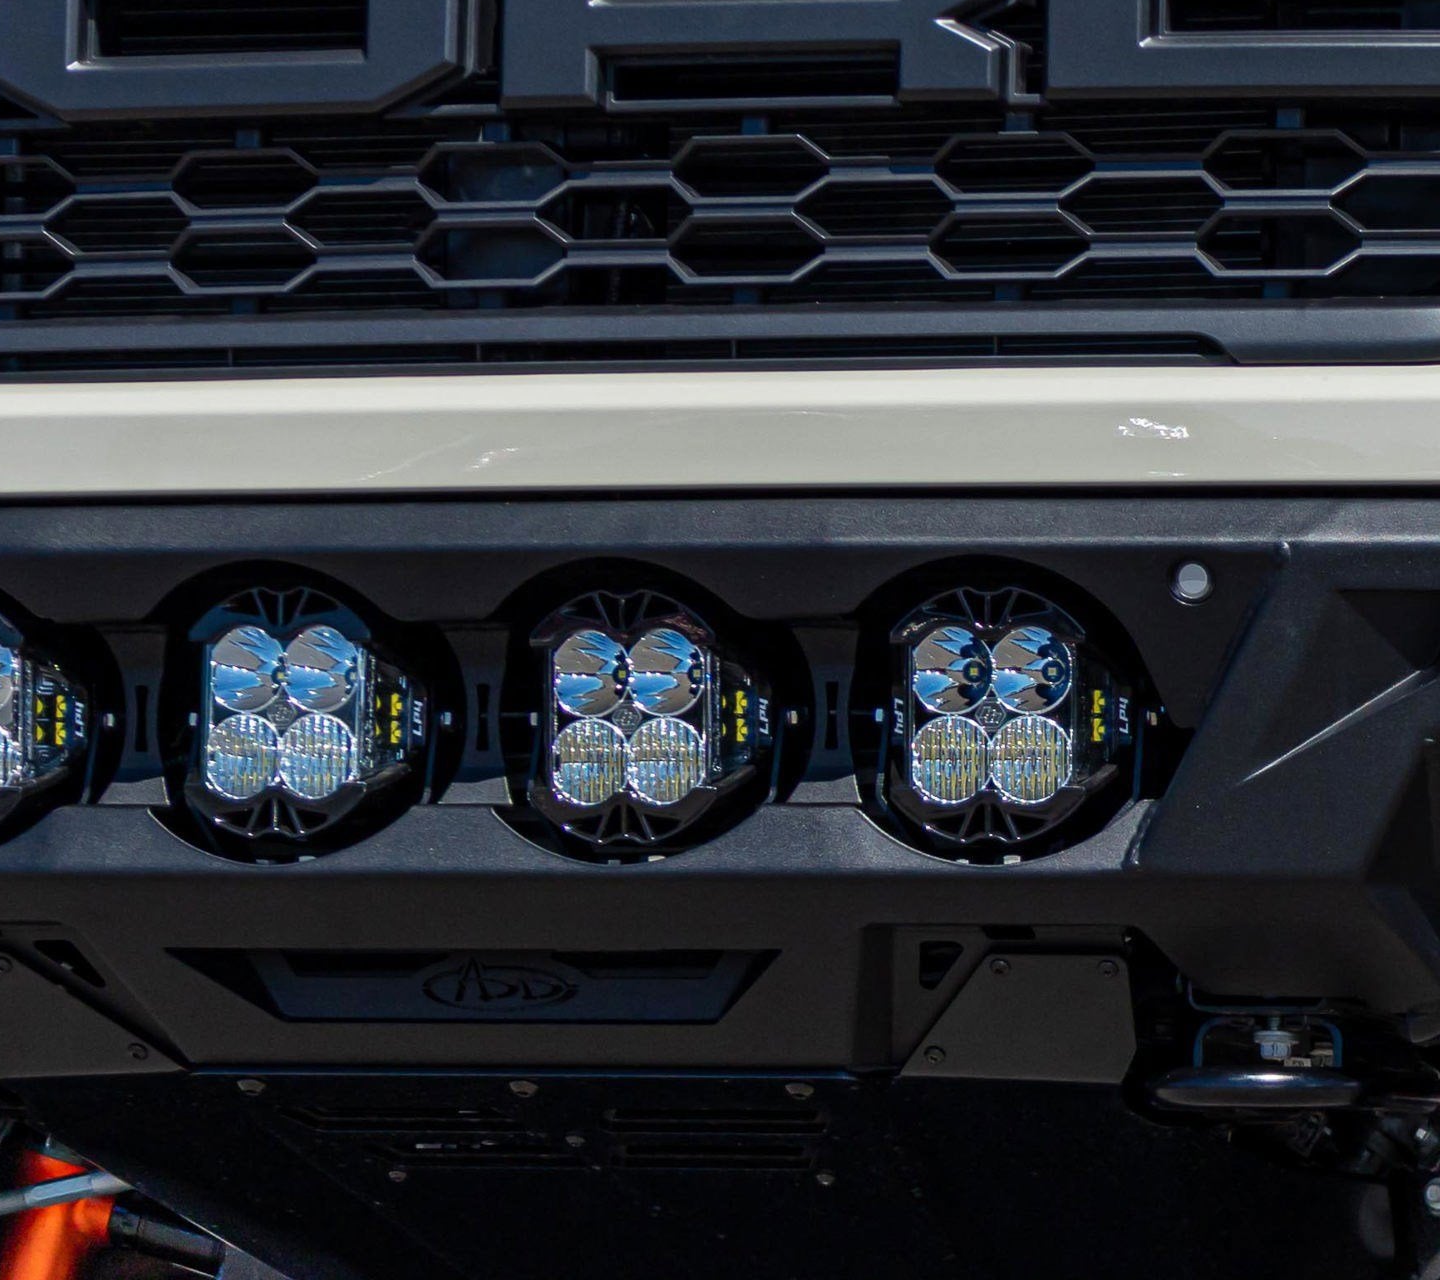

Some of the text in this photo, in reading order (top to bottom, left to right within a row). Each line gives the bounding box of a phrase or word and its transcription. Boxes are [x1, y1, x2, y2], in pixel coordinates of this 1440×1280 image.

[74, 700, 85, 738] LP4
[412, 700, 424, 737] LP4
[758, 697, 770, 736] LP4
[892, 697, 905, 735] LP4
[1117, 696, 1130, 735] LP4
